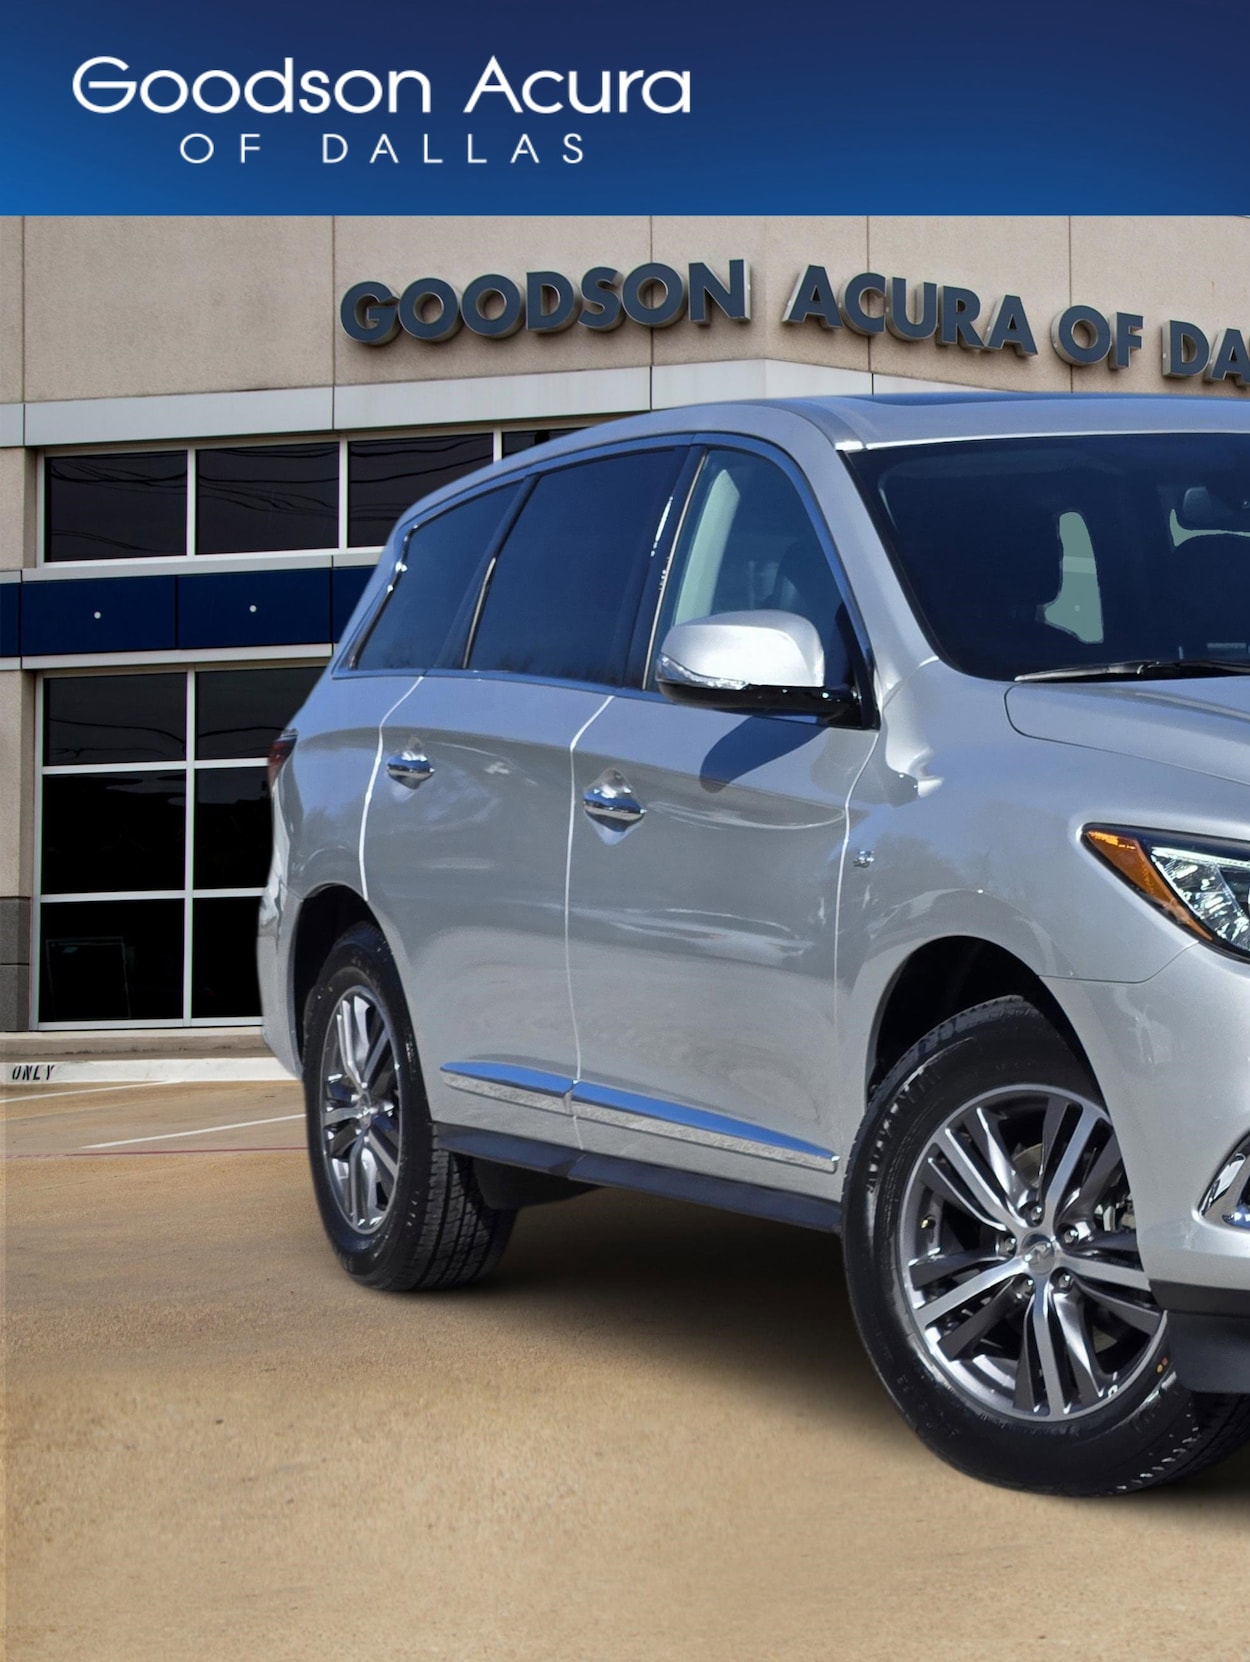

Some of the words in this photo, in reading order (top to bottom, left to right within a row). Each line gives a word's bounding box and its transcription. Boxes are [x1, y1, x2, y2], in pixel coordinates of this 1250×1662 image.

[340, 258, 750, 346] GOODSON
[782, 264, 1038, 357] ACURA
[1051, 305, 1143, 370] OF
[12, 1064, 55, 1081] ONLY
